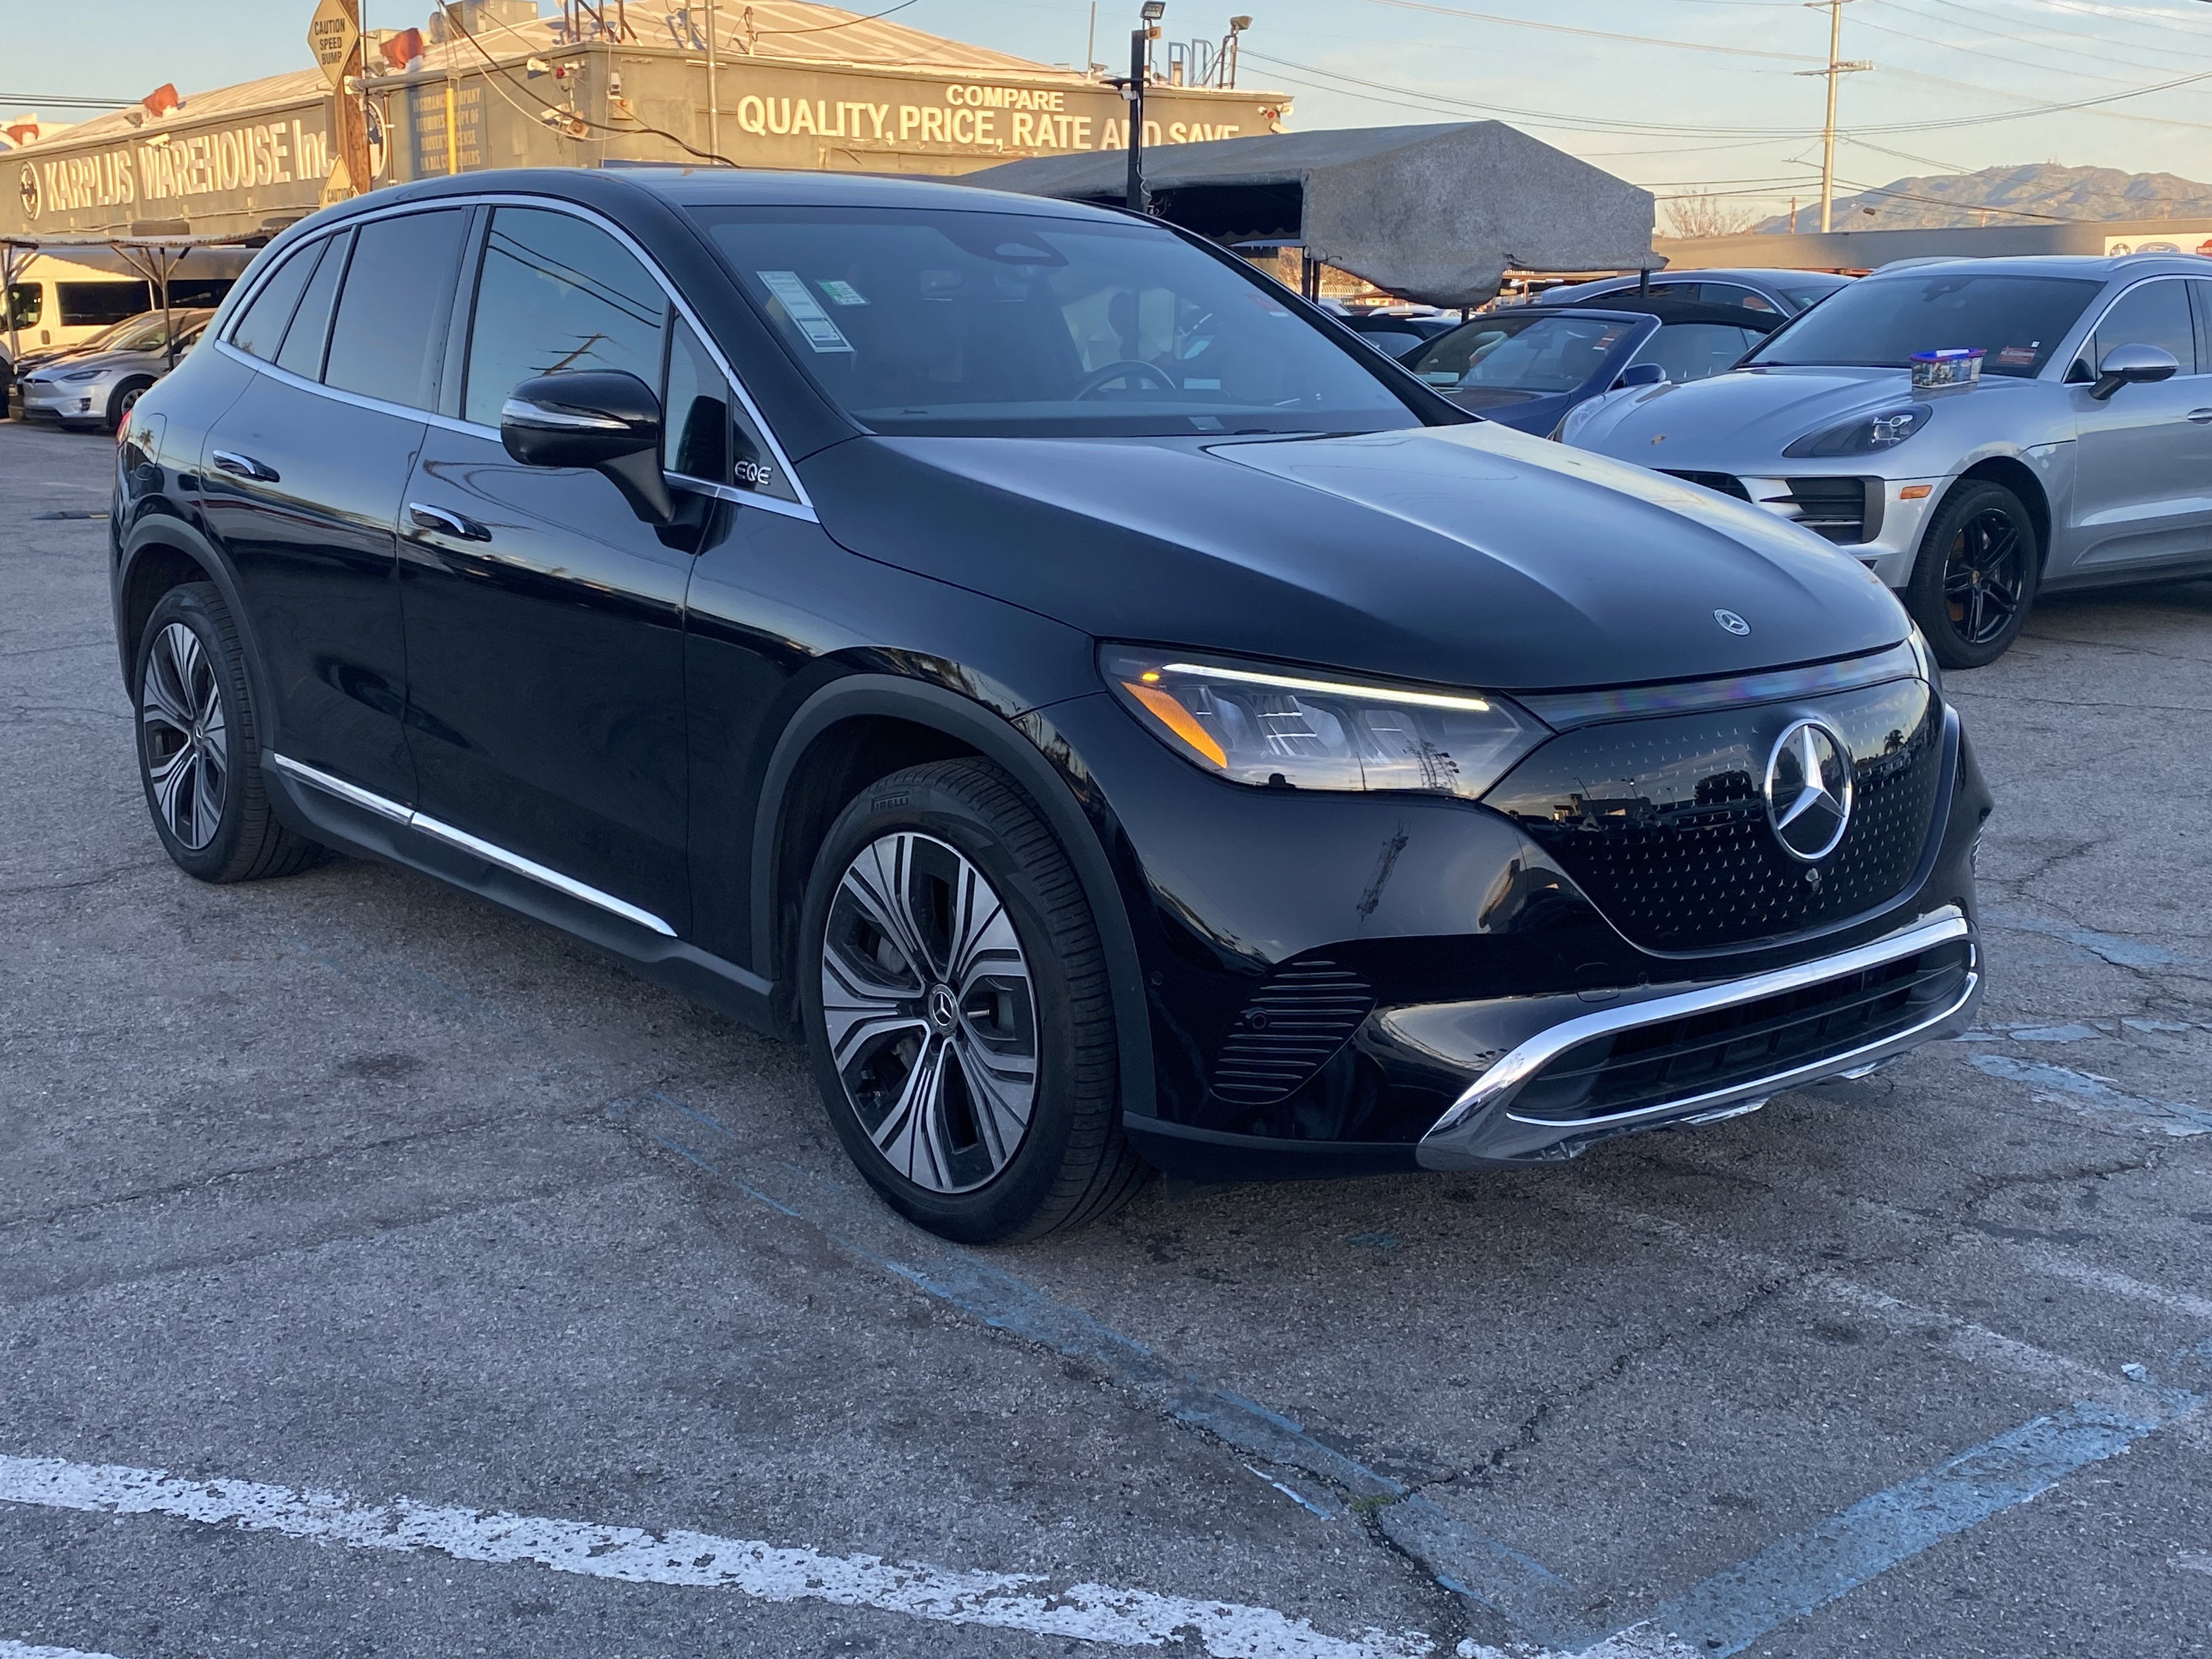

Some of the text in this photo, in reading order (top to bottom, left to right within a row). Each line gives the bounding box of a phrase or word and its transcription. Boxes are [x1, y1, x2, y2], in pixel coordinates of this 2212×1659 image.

[314, 18, 345, 36] CAUTION
[319, 37, 342, 50] SPEED
[321, 52, 342, 65] BUMP
[946, 84, 1064, 111] COMPARE
[737, 94, 895, 146] QUALITY,
[899, 105, 1003, 152] PRICE,
[1012, 112, 1092, 150] RATE
[43, 150, 134, 212] KARPLUS
[138, 122, 291, 200] WAREHOUSE
[328, 188, 351, 202] CAUTION
[734, 460, 772, 486] EQE
[870, 791, 911, 812] PIRELLI
